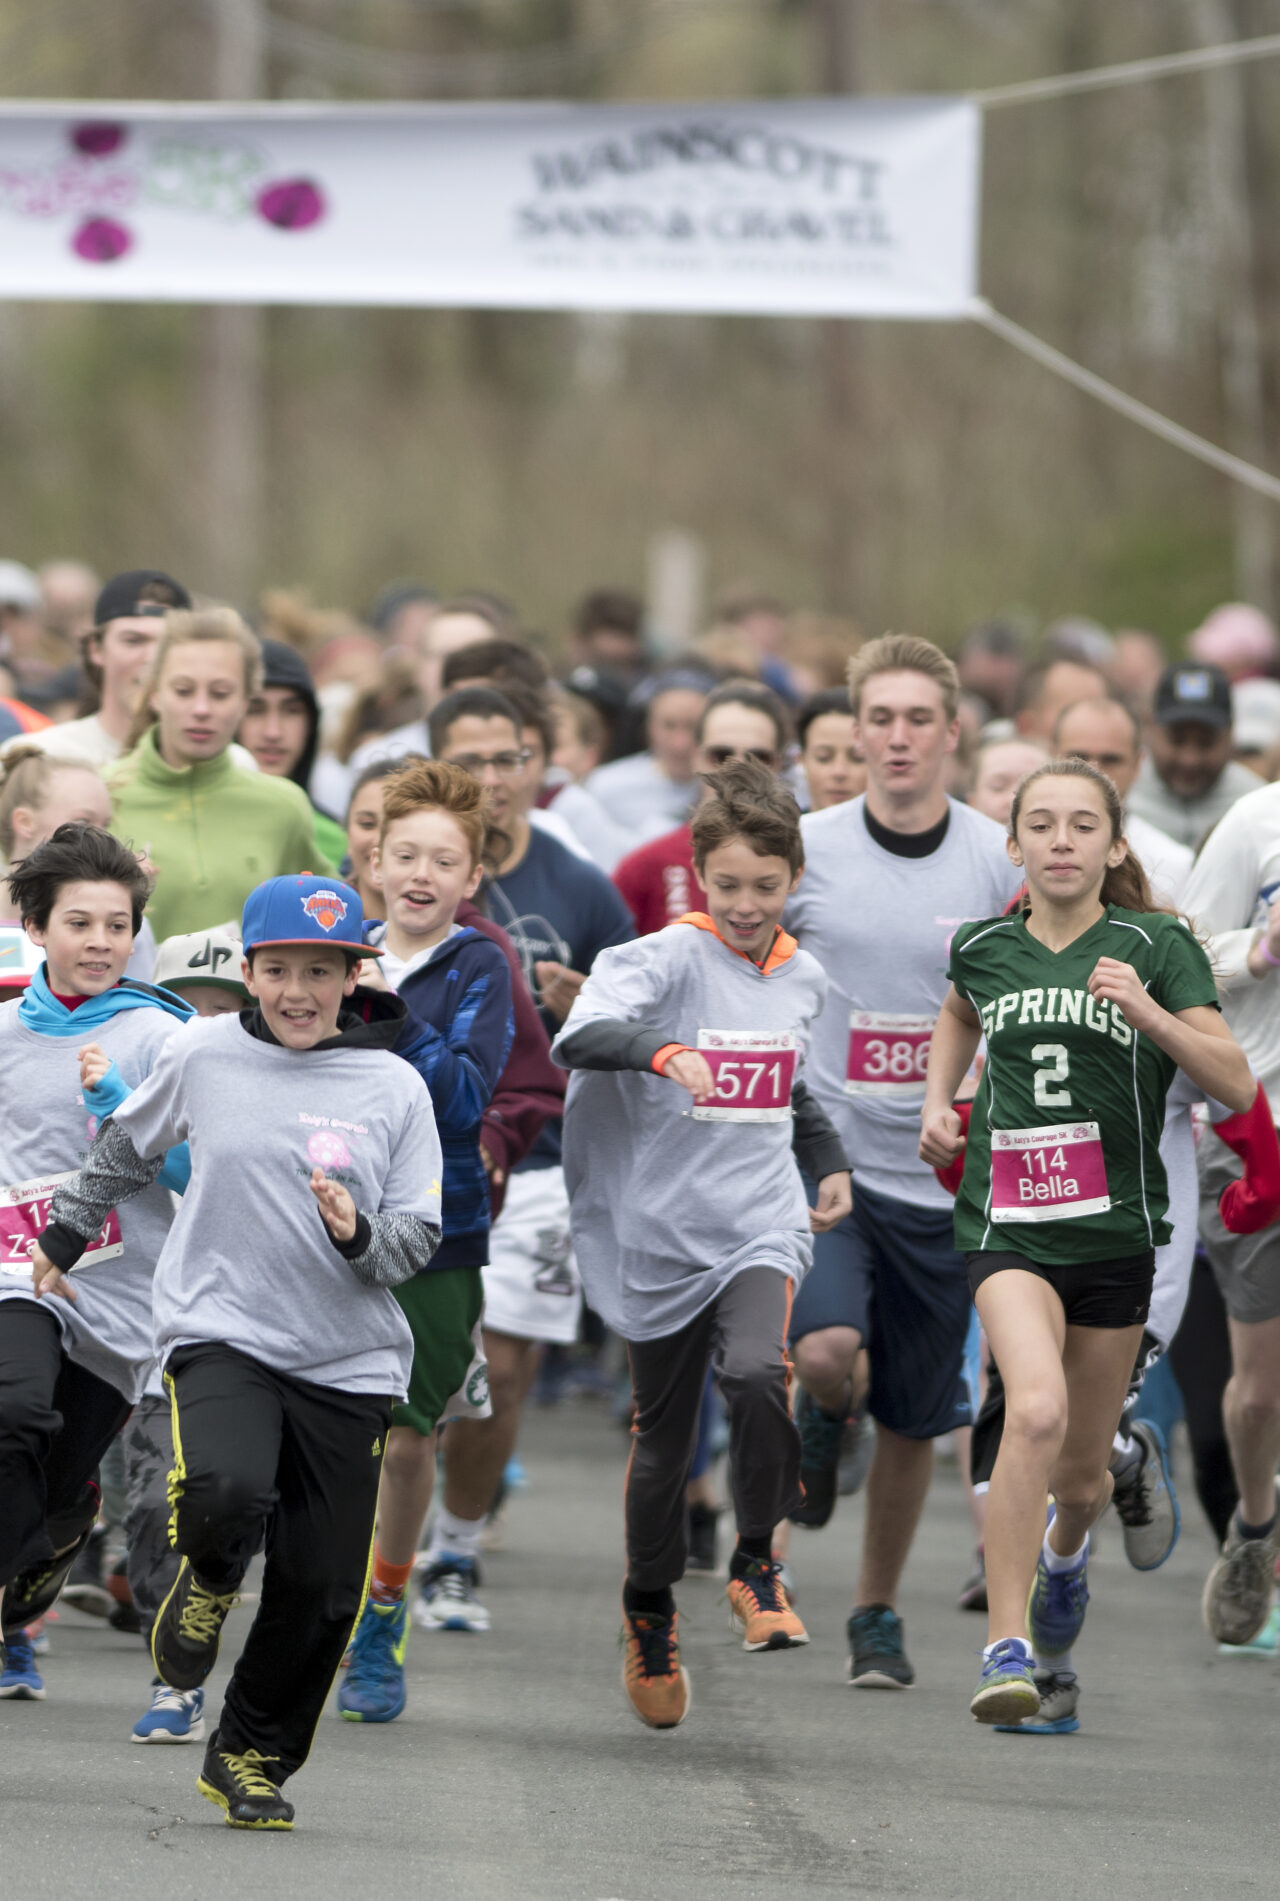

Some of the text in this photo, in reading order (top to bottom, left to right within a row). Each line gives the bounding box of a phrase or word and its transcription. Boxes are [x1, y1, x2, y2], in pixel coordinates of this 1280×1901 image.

[531, 123, 888, 201] WAINSCOTT
[516, 205, 658, 243] SAND
[981, 987, 1132, 1047] SPRINGS
[863, 1039, 932, 1077] 386
[1031, 1043, 1072, 1106] 2
[715, 1061, 781, 1099] 571
[1013, 1136, 1030, 1145] Katy's
[1031, 1134, 1057, 1142] Courage
[1021, 1146, 1068, 1175] 114
[39, 1183, 61, 1193] Cour
[1018, 1175, 1080, 1201] Bella
